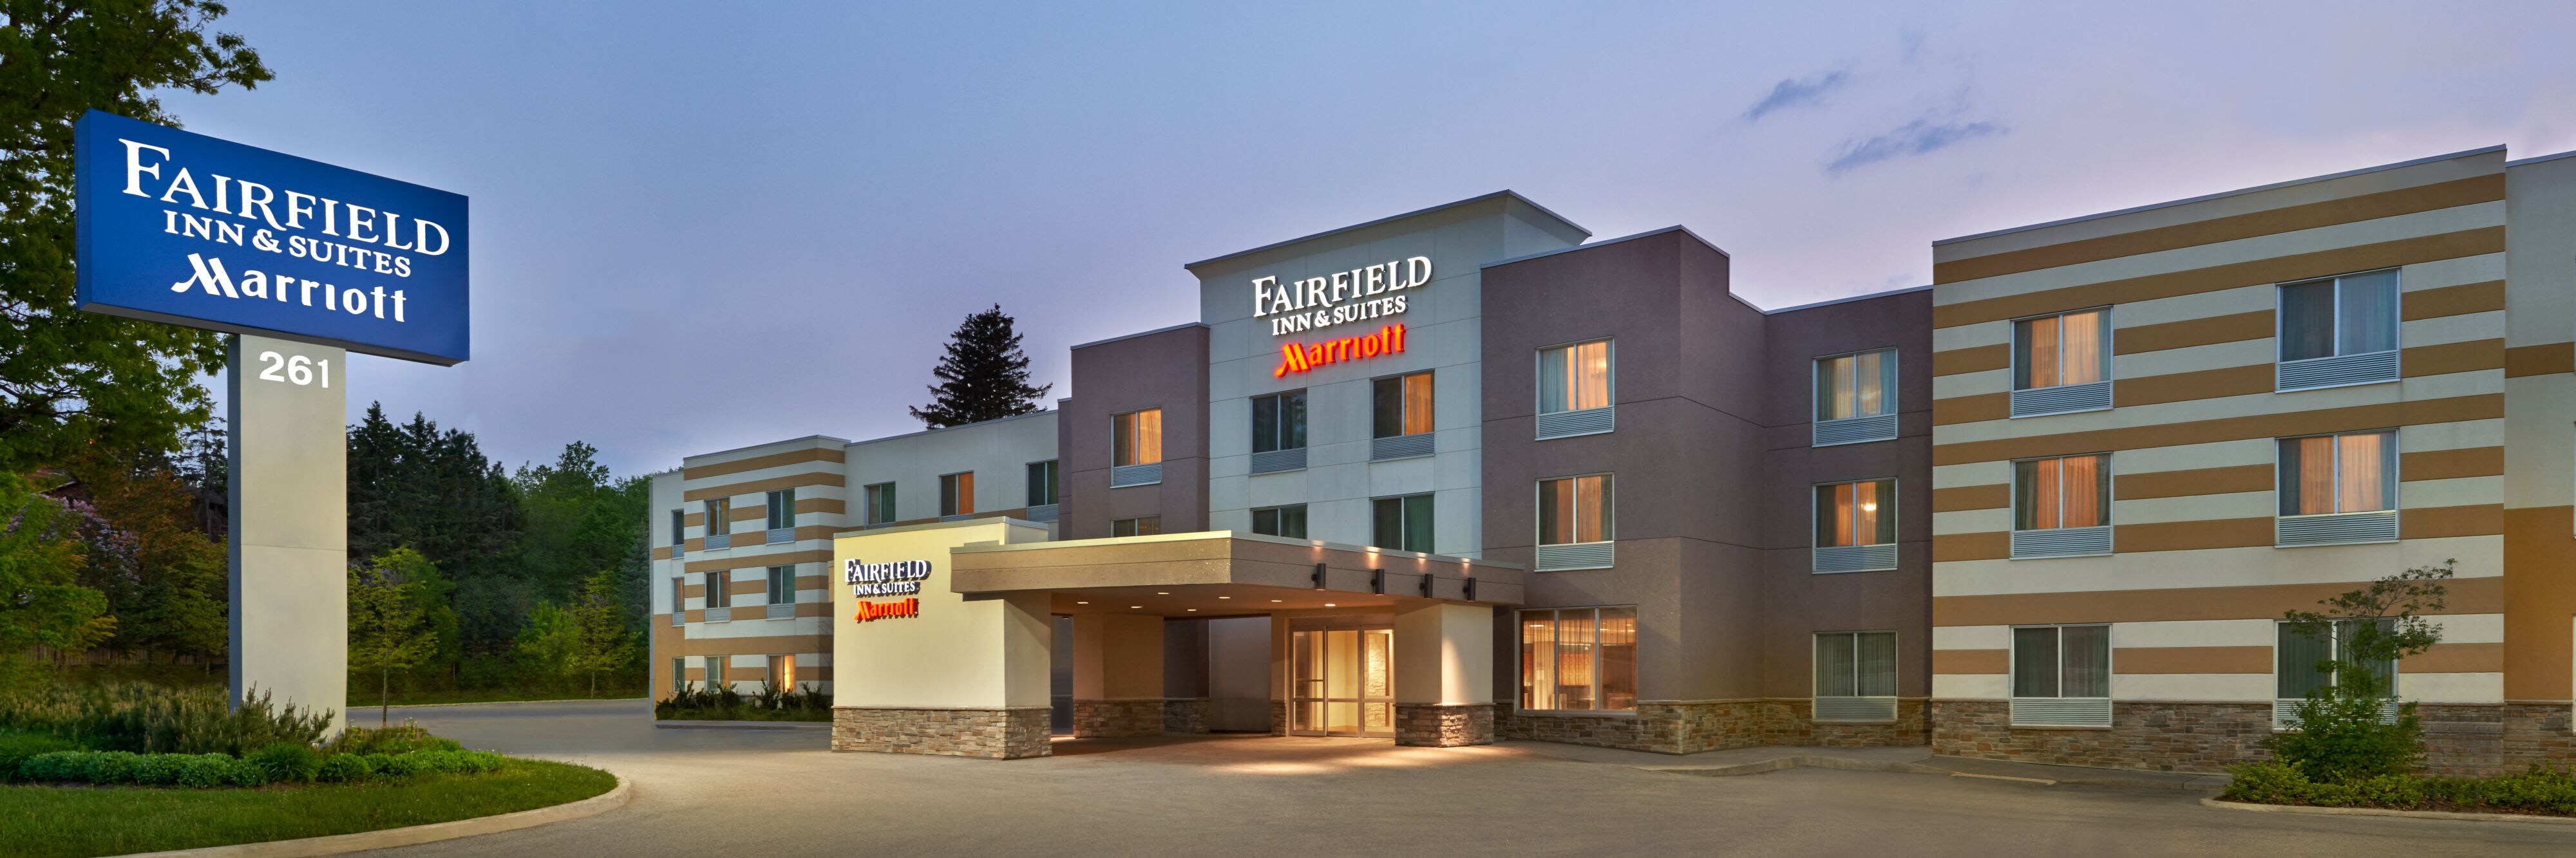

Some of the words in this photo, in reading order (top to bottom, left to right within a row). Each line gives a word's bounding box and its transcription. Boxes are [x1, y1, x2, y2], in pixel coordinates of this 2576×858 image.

[118, 138, 450, 256] FAIRFIELD
[163, 210, 245, 247] INN
[252, 229, 282, 253] &
[289, 235, 411, 278] SUITES
[171, 253, 406, 322] Marriott
[1252, 256, 1432, 317] FAIRFIELD
[1272, 312, 1312, 335] INN
[1314, 310, 1331, 327] &
[1334, 295, 1406, 324] SUITES
[259, 351, 329, 389] 261
[1274, 323, 1405, 377] Marriott
[844, 558, 927, 583] FAIRFIELD
[853, 584, 871, 595] INN
[873, 584, 880, 594] &
[882, 581, 915, 593] SUITES
[854, 598, 915, 620] Marriott
